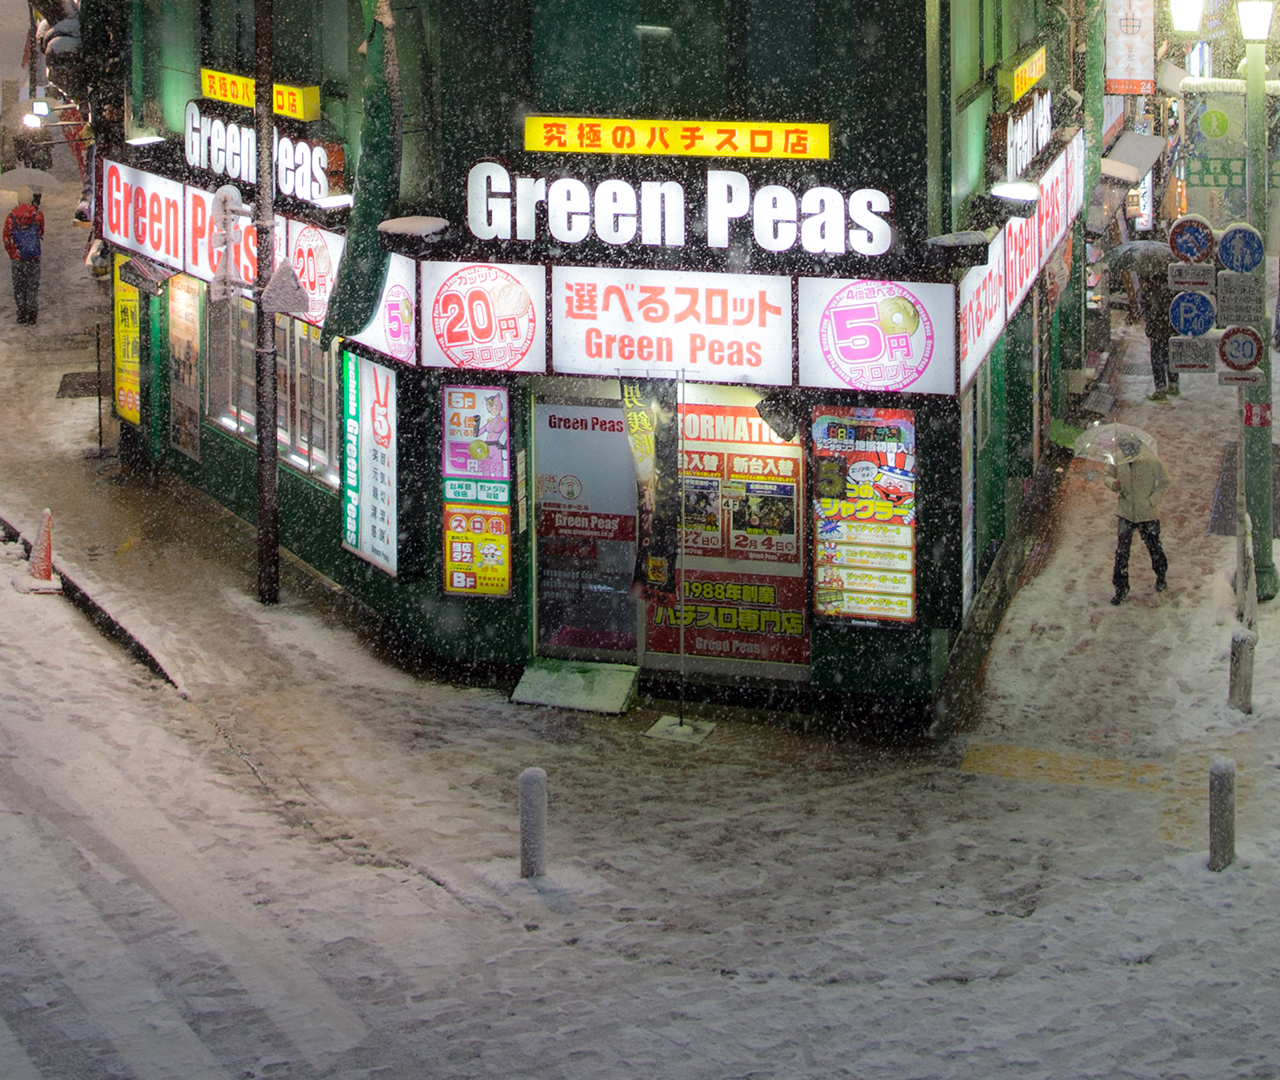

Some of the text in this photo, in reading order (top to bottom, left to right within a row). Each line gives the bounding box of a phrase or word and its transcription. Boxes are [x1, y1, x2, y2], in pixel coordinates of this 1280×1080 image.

[207, 73, 298, 114] 究極のパロ店
[1141, 81, 1152, 90] 24
[184, 102, 257, 186] Green
[542, 122, 810, 155] 究極のパチスロ店
[107, 164, 179, 260] Green
[467, 162, 892, 256] Green Peas
[1006, 175, 1061, 308] Green Peas
[439, 288, 522, 348] 20円
[564, 281, 783, 331] 選べるスロット
[835, 298, 916, 362] 5円
[461, 346, 520, 365] スロット
[584, 327, 762, 368] Green Peas
[1229, 340, 1254, 358] 30
[848, 361, 916, 384] スロット
[451, 392, 474, 409] 5F
[548, 414, 624, 433] Green Peas
[678, 413, 800, 445] ORMATI
[733, 456, 794, 476] 新台入替
[554, 513, 619, 531] Green Peas
[821, 498, 910, 520] ジャグラー
[452, 572, 476, 589] BF
[684, 581, 776, 606] 1988年創業
